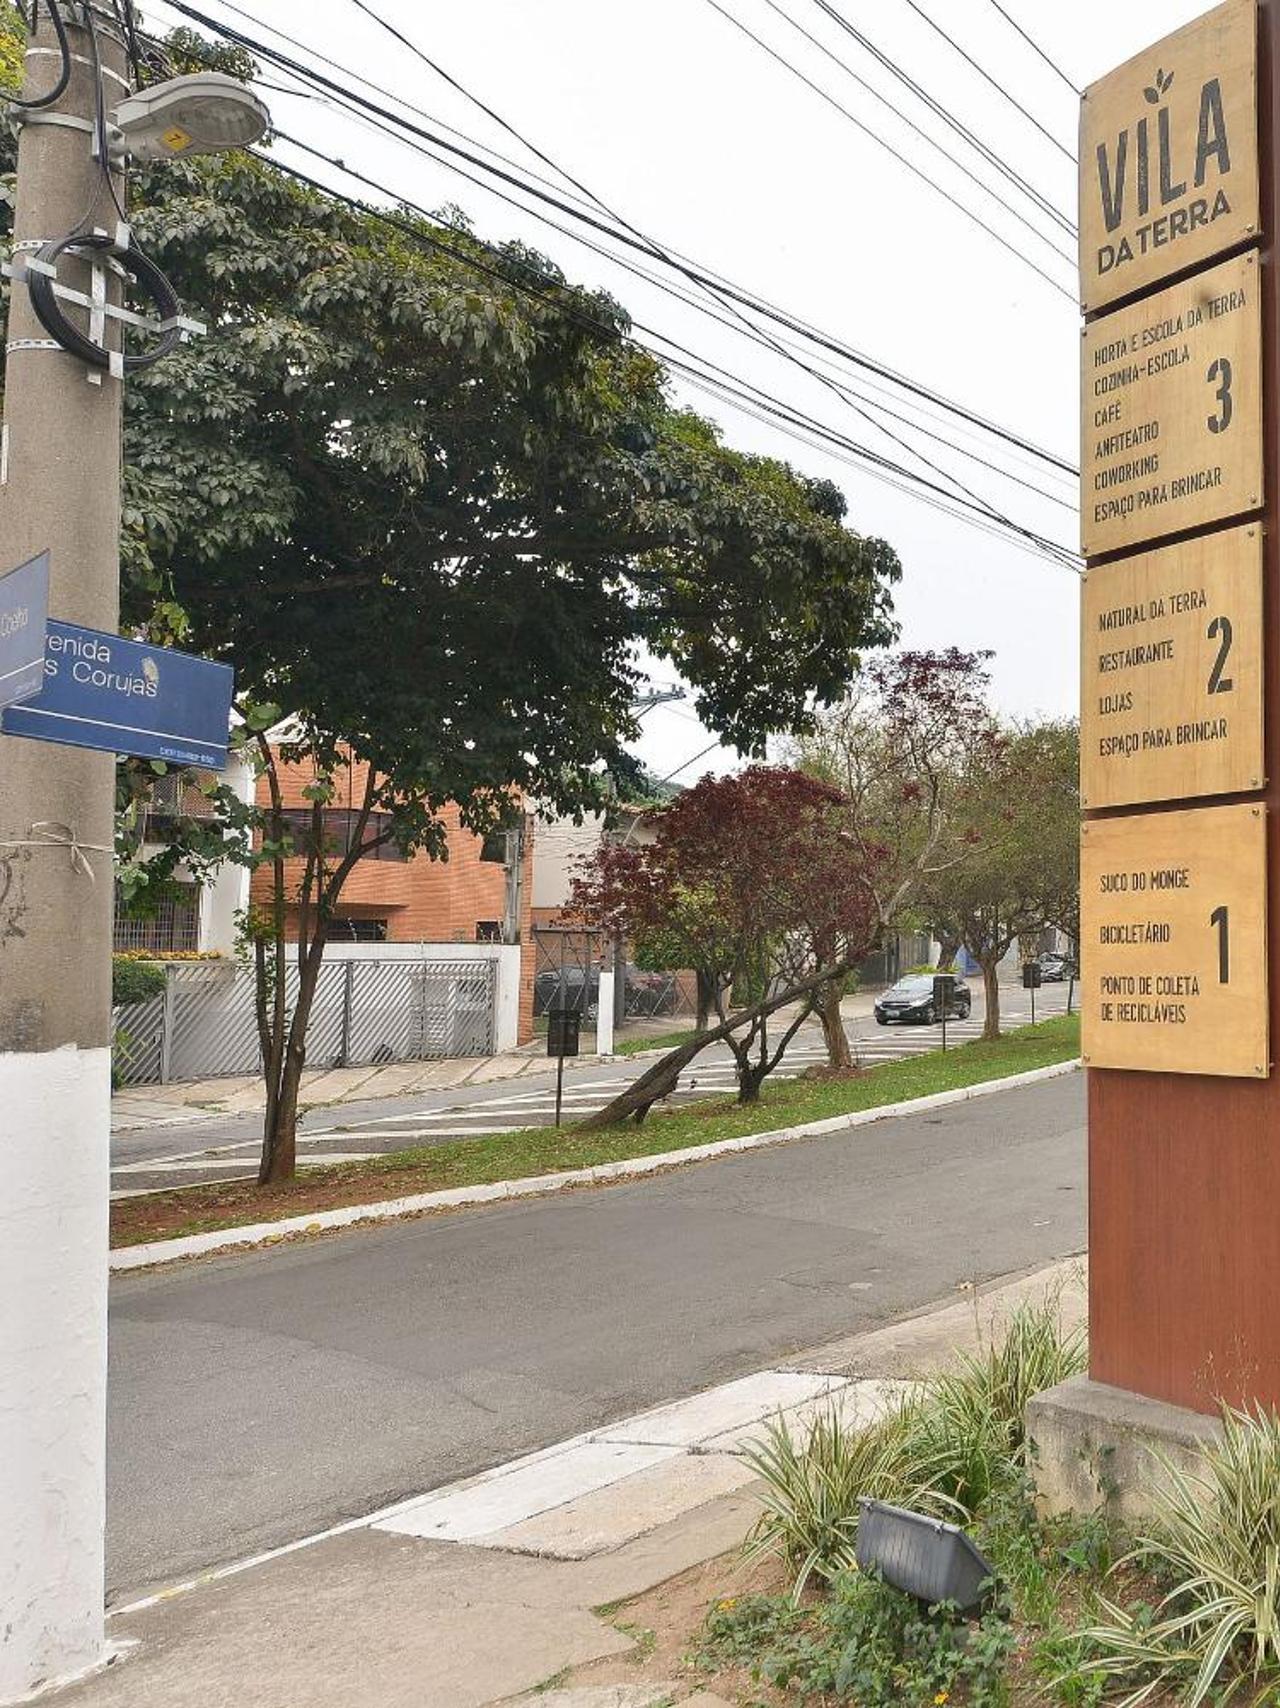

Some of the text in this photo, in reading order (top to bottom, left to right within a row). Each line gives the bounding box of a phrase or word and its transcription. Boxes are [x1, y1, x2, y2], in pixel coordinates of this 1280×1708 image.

[1097, 78, 1230, 232] VILA
[1098, 189, 1231, 275] DA TERRA
[1095, 288, 1246, 367] HORTA E ESCOLA DA TERRA
[1094, 344, 1190, 396] COZINHA-ESCOLA
[1094, 400, 1121, 427] CAFÉ
[1207, 358, 1232, 434] 3
[1095, 421, 1159, 460] ANFITEATRO
[1094, 455, 1159, 491] COWORKING
[1095, 467, 1221, 523] ESPAÇO PARA BRINCAR
[1099, 589, 1207, 632] NATURAL DA TERRA
[46, 635, 110, 663] enida
[1099, 640, 1174, 673] RESTAURANTE
[1207, 616, 1233, 695] 2
[73, 661, 158, 698] Corujas
[1099, 692, 1133, 715] LOJAS
[1099, 719, 1228, 758] ESPAÇO PARA BRINCAR
[1100, 869, 1190, 893] SUCO DO MONGE
[1100, 921, 1170, 945] BICICLETÁRIO
[1210, 905, 1230, 984] 1
[1100, 976, 1200, 996] PONTO DE COLETA
[1101, 1000, 1186, 1024] DE RECICLÁVEIS
